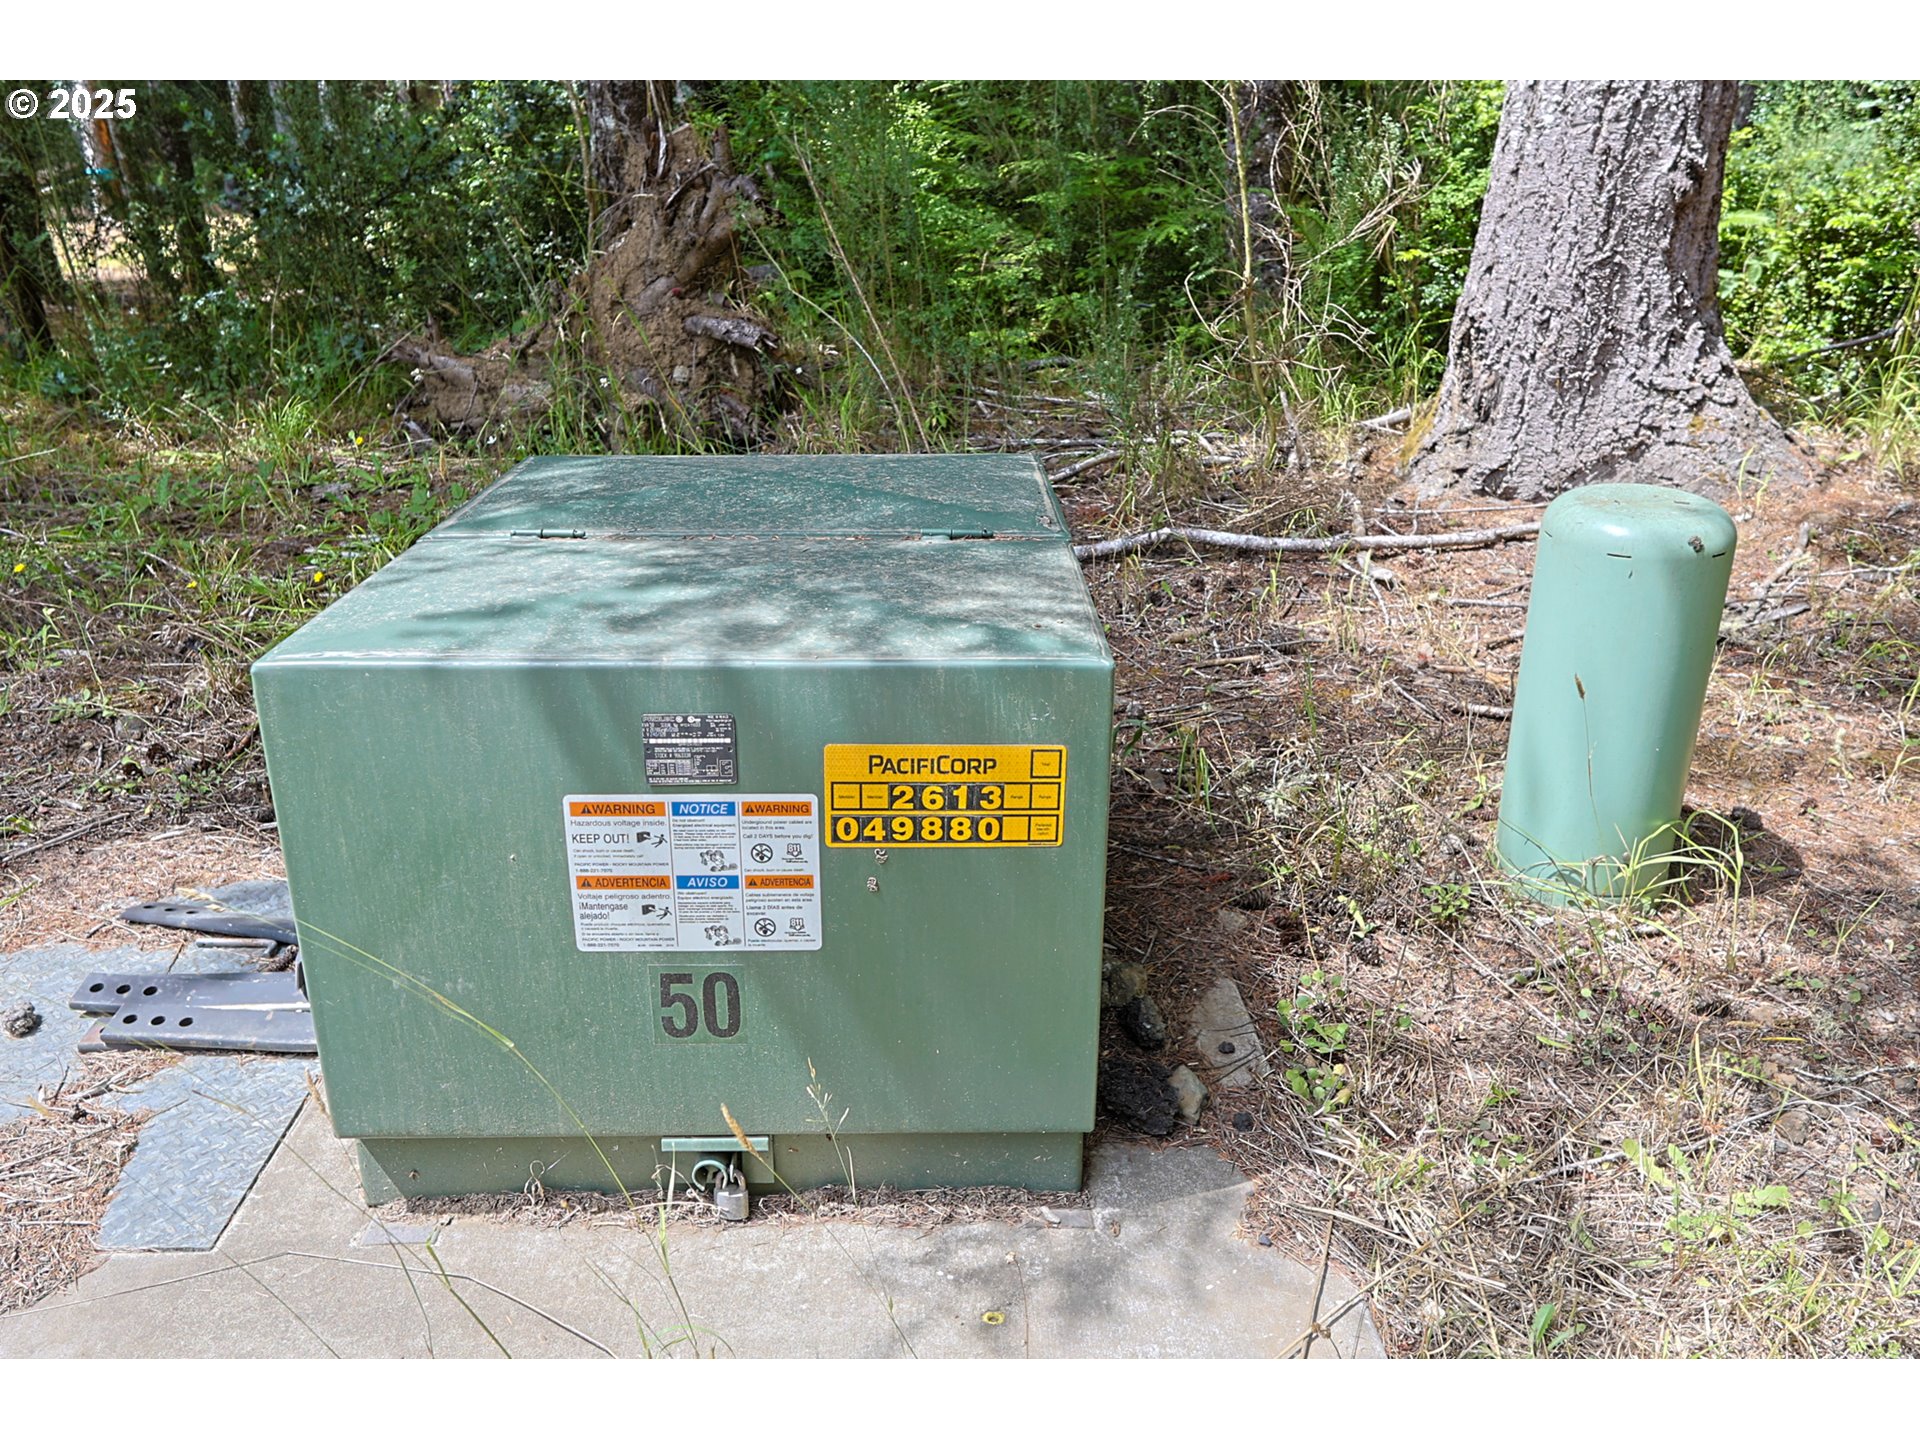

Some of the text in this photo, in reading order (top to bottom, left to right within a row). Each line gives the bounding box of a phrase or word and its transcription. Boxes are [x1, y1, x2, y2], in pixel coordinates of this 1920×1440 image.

[868, 754, 997, 774] PACIFICORP
[892, 786, 1002, 810] 2613
[591, 804, 656, 814] WARNING
[679, 804, 728, 814] NOTICE
[754, 804, 809, 813] WARNING
[836, 816, 1000, 842] 049880
[572, 834, 630, 844] KEEP OUT!
[788, 844, 800, 852] 811
[595, 878, 666, 888] ADVERTENCIA
[687, 877, 728, 888] AVISO
[760, 878, 811, 886] ADVERTENCIA
[580, 912, 610, 921] alejado!
[660, 972, 740, 1038] 50
